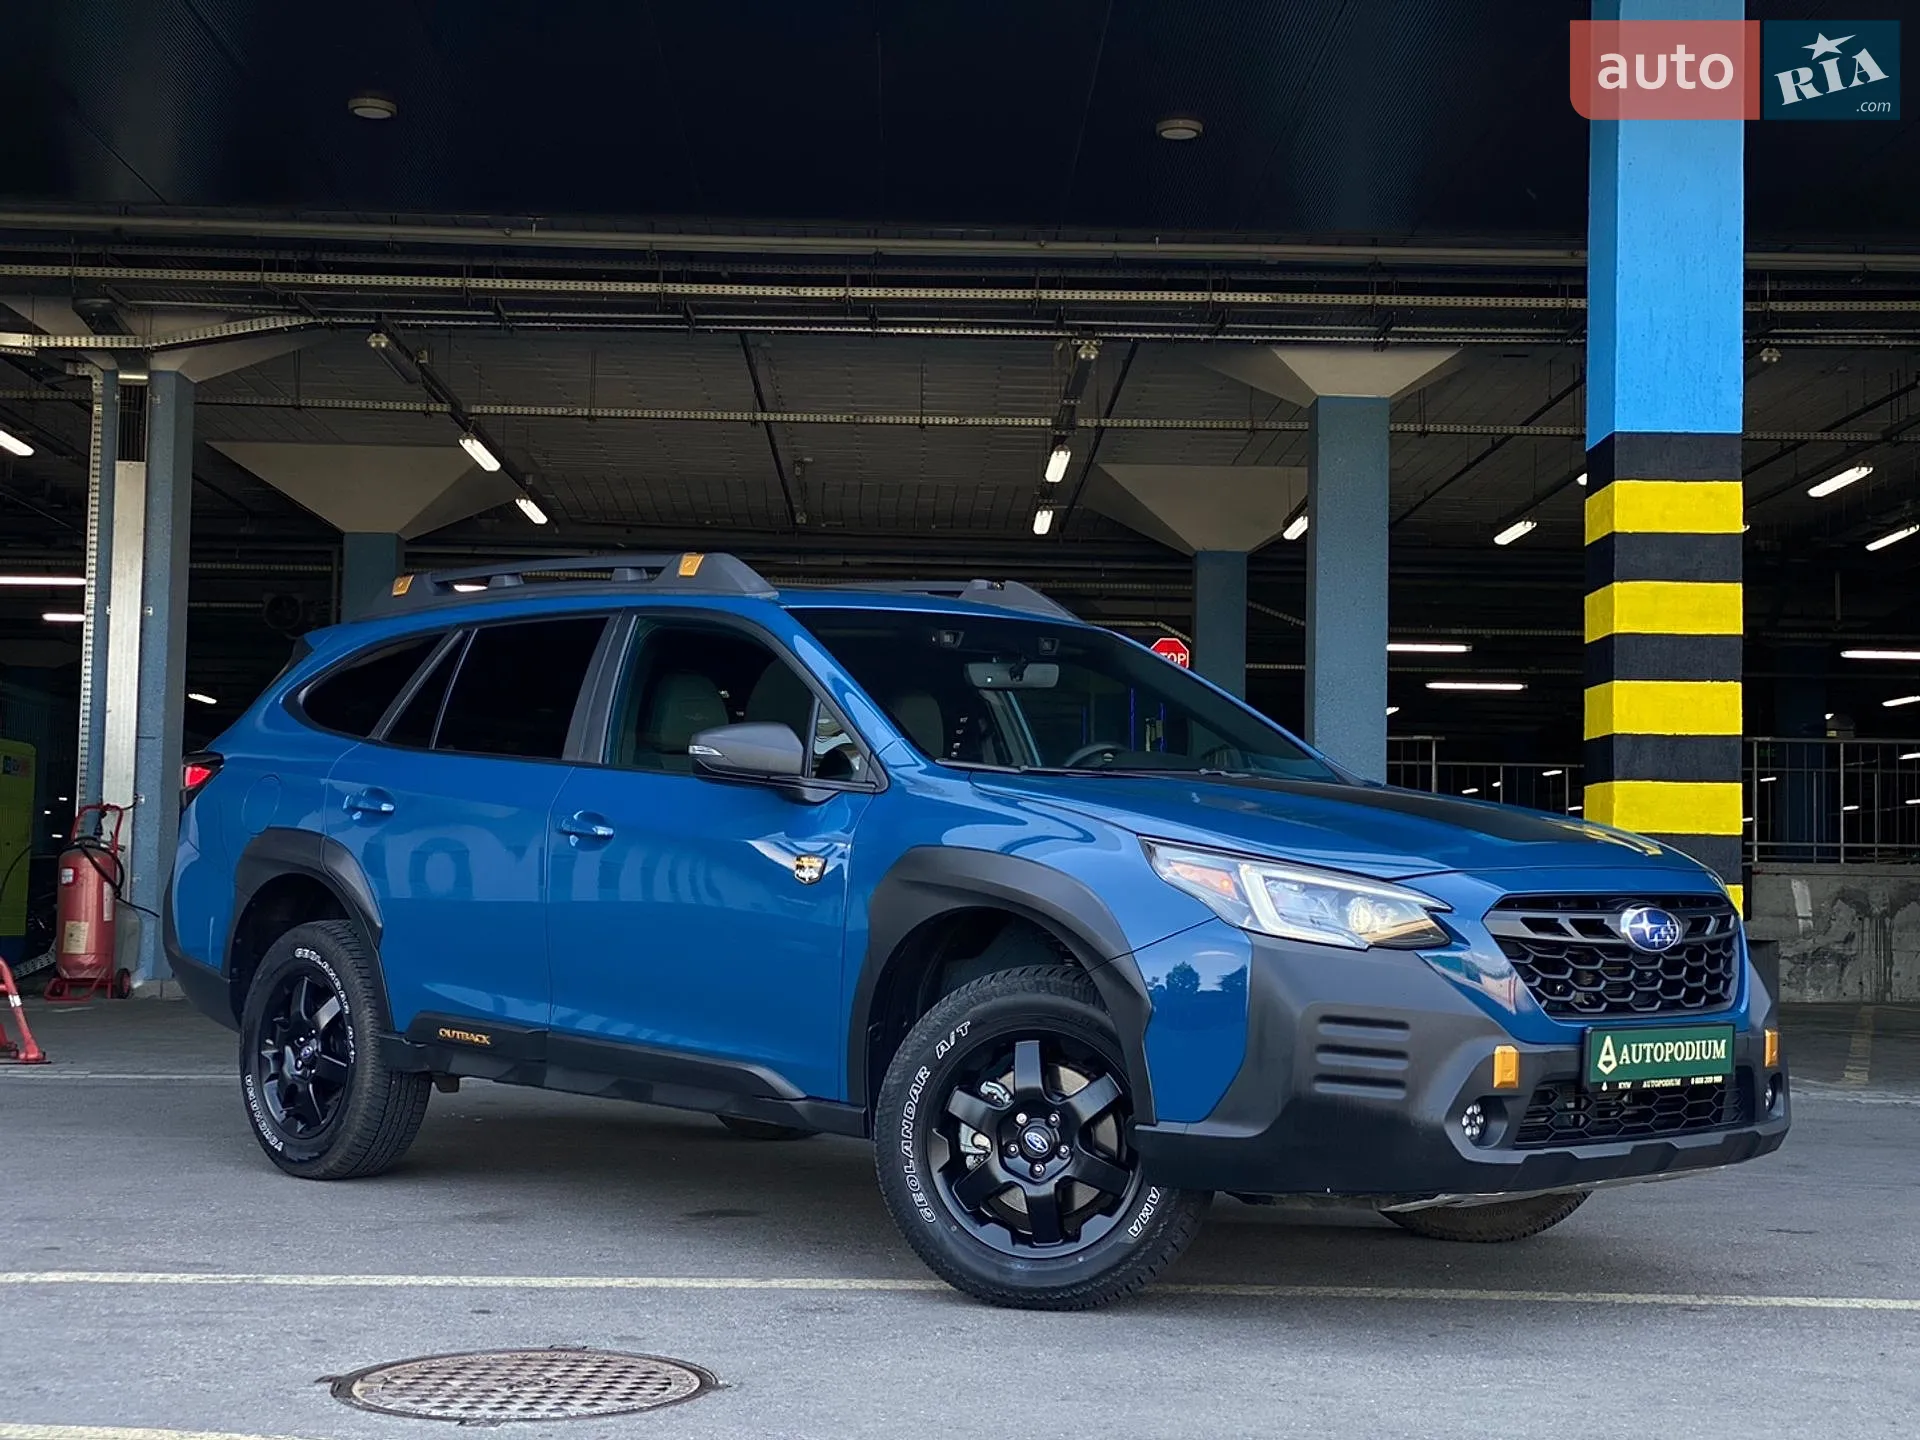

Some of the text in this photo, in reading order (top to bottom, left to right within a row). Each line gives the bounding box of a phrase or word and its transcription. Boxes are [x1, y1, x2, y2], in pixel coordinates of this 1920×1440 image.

[439, 1028, 491, 1045] OUTBACK
[1619, 1039, 1726, 1064] AUTOPODIUM
[901, 1021, 970, 1223] GEOLANDAR A/T
